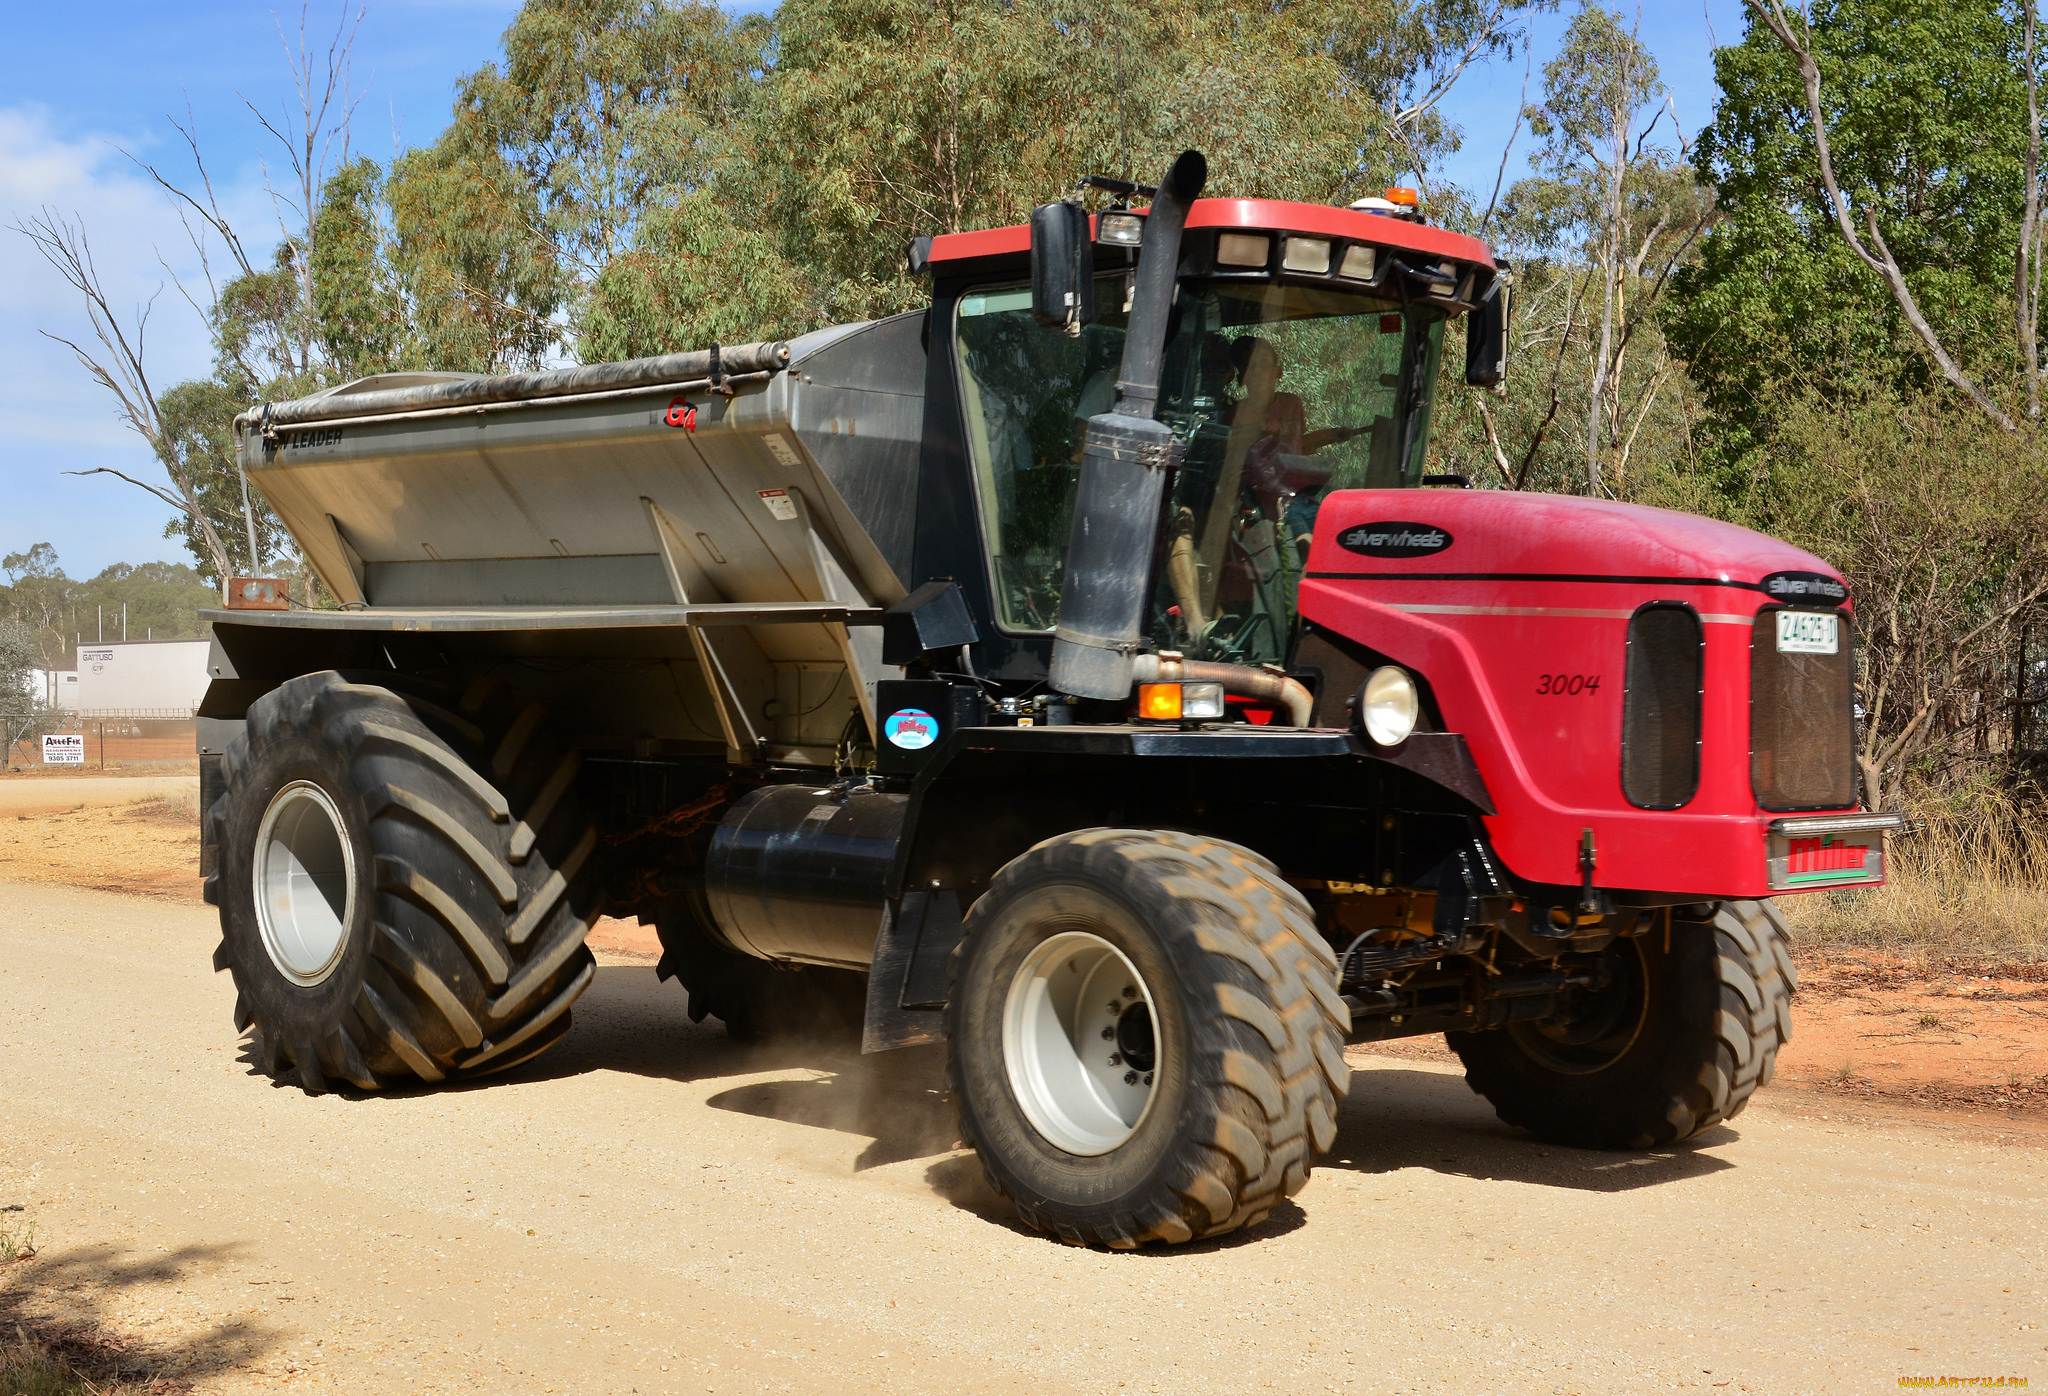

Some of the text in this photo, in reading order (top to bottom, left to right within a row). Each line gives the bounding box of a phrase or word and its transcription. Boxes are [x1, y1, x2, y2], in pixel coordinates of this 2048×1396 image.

[665, 396, 698, 433] G4
[292, 429, 343, 449] LEADER
[1345, 529, 1446, 547] silverwheels
[1536, 674, 1601, 696] 3004
